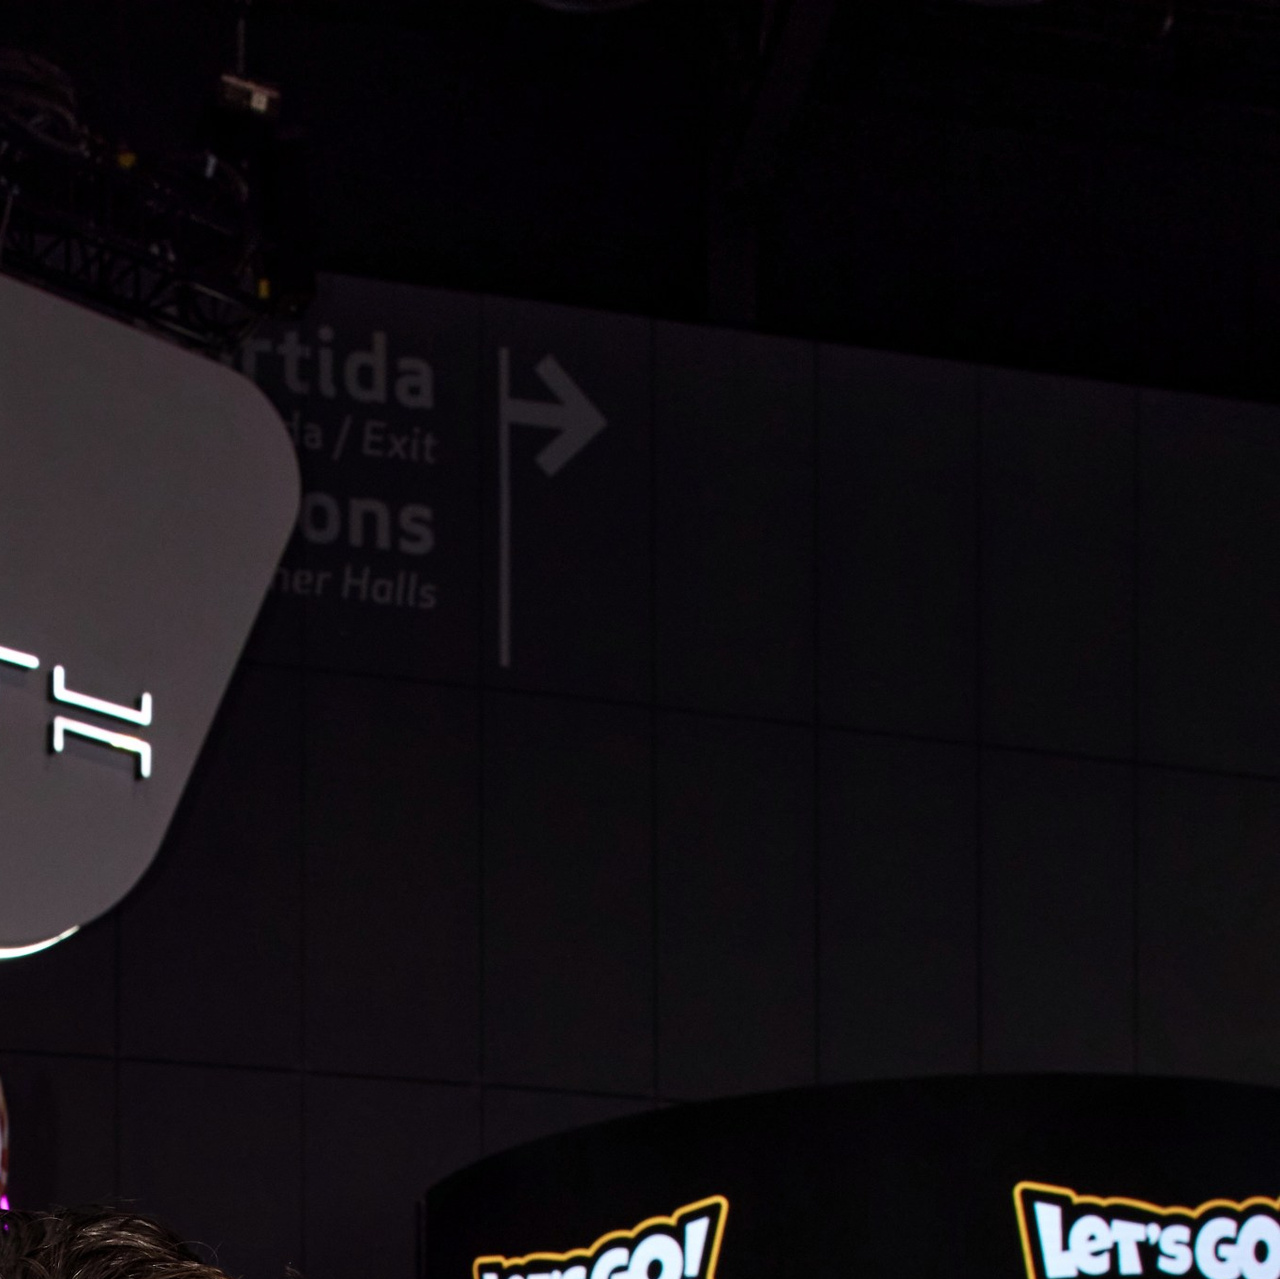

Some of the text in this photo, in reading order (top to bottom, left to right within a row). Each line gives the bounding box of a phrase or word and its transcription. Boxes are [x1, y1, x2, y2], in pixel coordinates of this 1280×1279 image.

[240, 325, 435, 410] rtida
[362, 419, 441, 464] Exit
[340, 562, 439, 610] Halls
